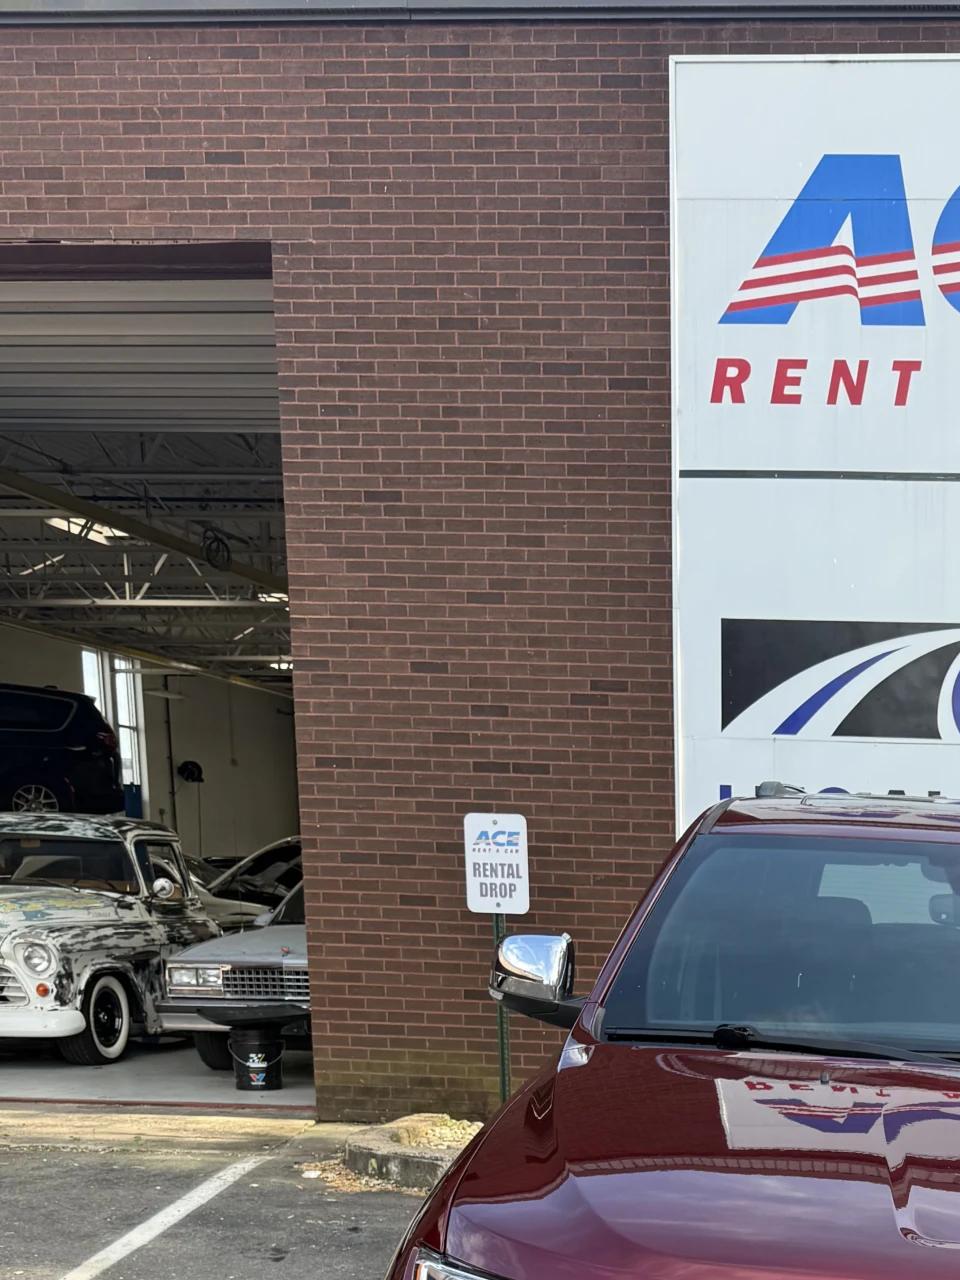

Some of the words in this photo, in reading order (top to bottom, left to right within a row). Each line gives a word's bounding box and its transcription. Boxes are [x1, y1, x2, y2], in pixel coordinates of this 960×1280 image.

[709, 358, 921, 405] RENT
[473, 831, 520, 846] ACE
[473, 862, 522, 879] RENTAL
[480, 882, 517, 898] DROP
